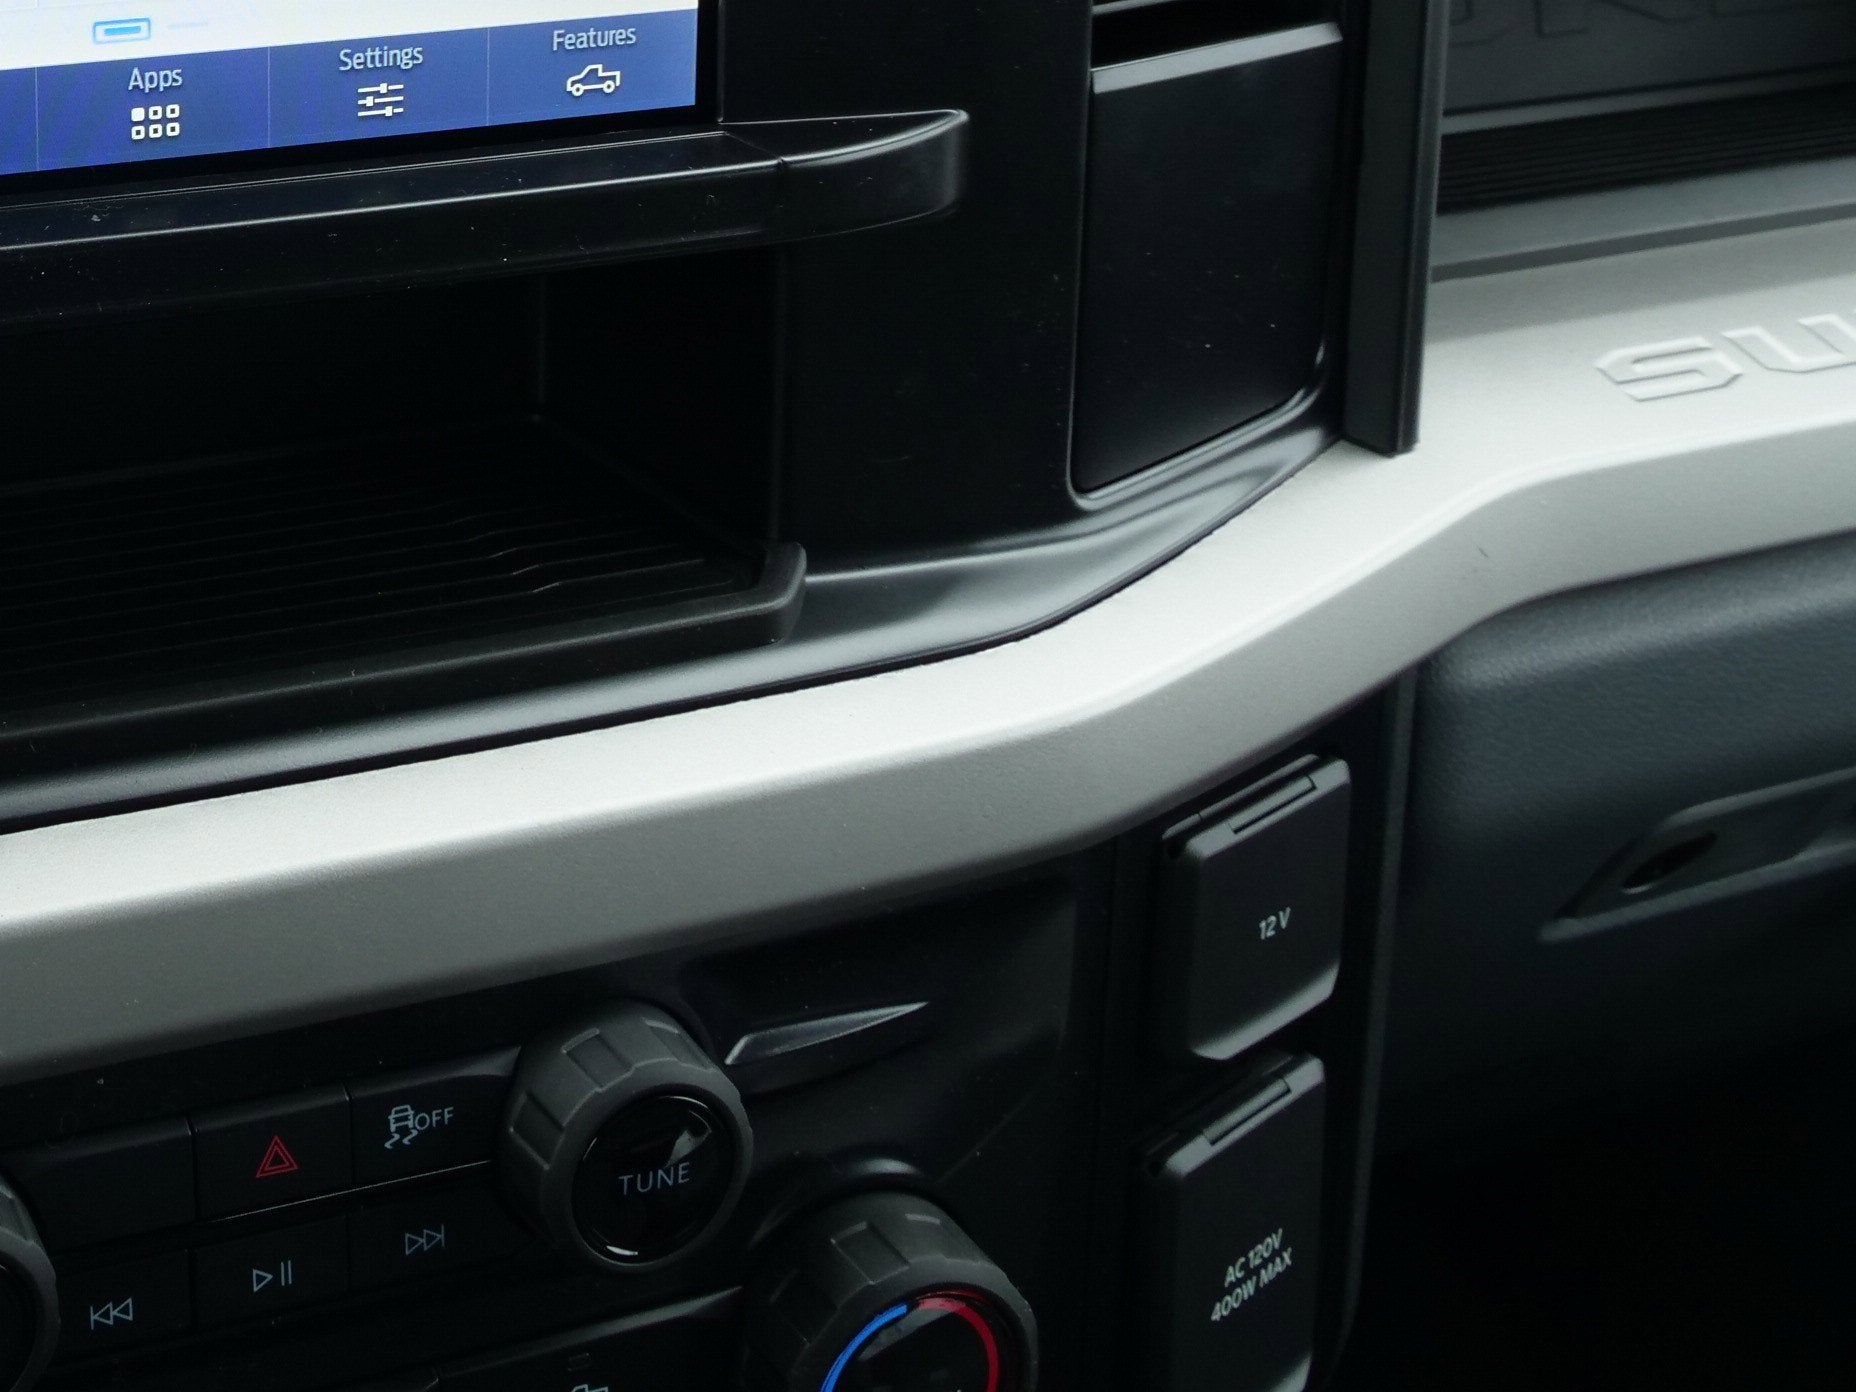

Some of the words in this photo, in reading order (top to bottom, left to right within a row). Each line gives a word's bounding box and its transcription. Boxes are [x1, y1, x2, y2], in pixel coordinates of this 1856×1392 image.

[551, 23, 638, 52] Features
[338, 42, 424, 74] Settings
[128, 66, 183, 93] Apps
[415, 1107, 455, 1132] OFF
[619, 1161, 692, 1196] TUNE
[1224, 1256, 1246, 1288] AC
[1247, 1228, 1284, 1269] 120V
[1210, 1276, 1256, 1322] 400W
[1259, 1247, 1292, 1288] MAX
